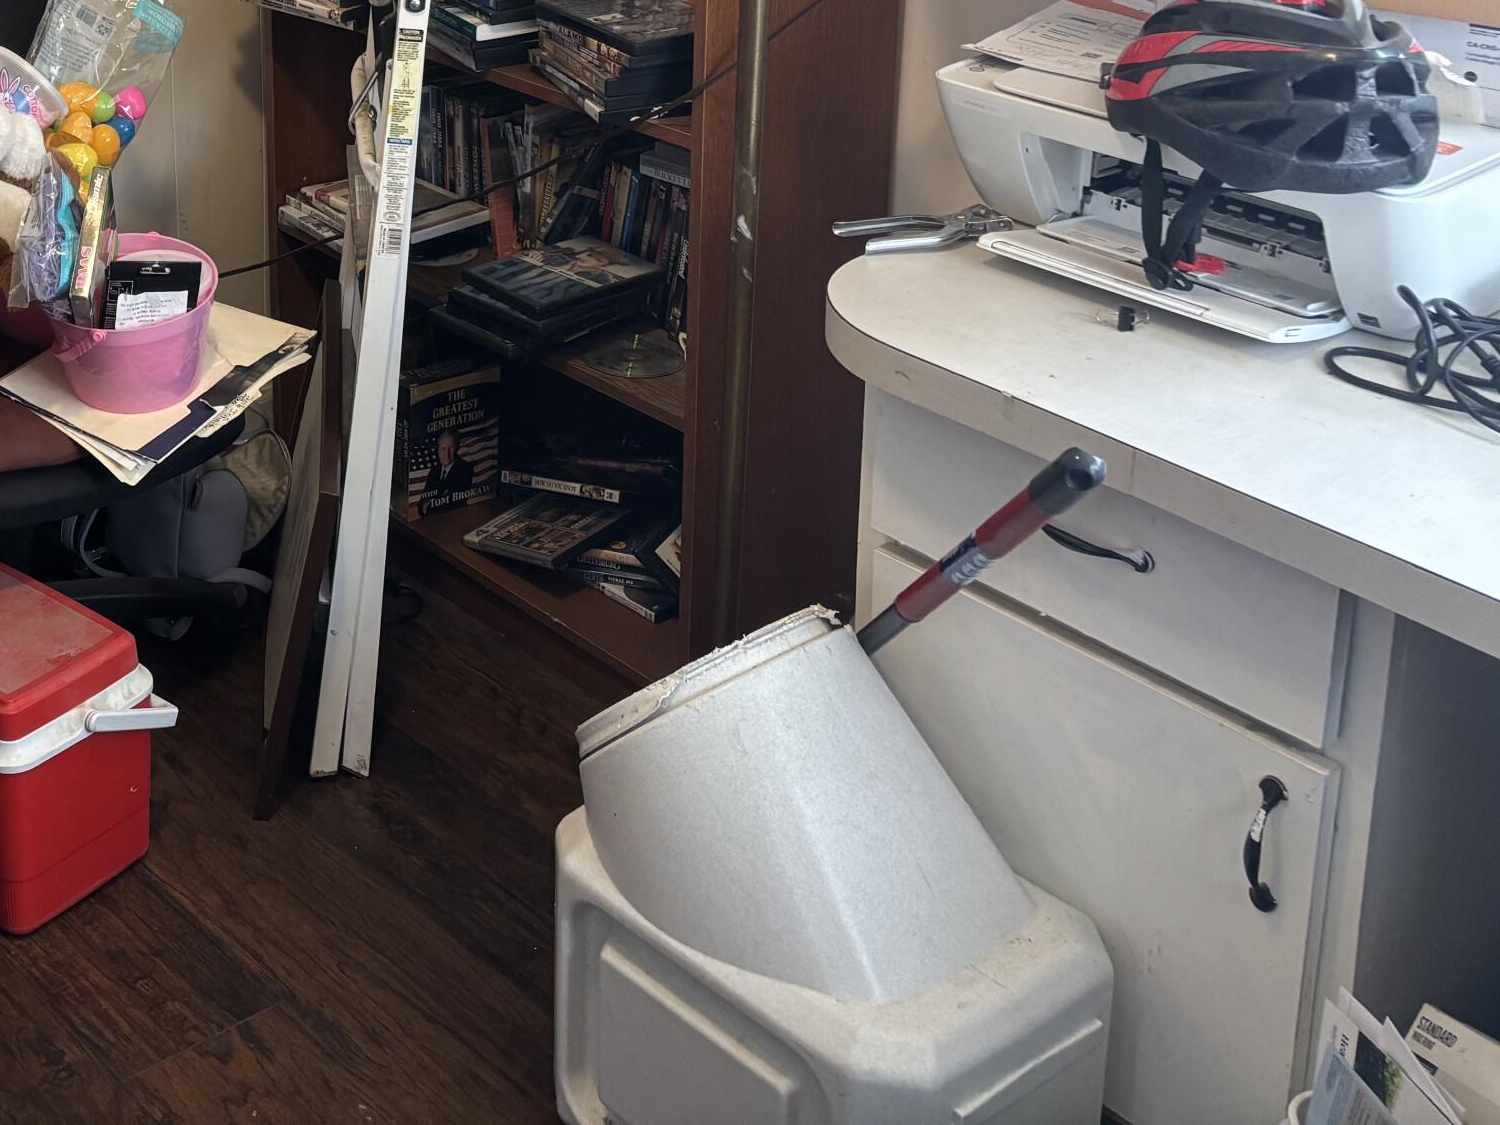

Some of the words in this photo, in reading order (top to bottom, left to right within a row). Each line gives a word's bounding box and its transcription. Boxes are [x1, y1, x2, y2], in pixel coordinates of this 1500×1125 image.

[1466, 41, 1500, 52] CA-CRG-
[74, 245, 93, 291] PAAS
[447, 388, 466, 401] THE
[432, 398, 478, 419] GREATEST
[427, 410, 485, 433] GENERATION
[428, 493, 450, 509] TOM
[1417, 1016, 1458, 1048] STANDARD
